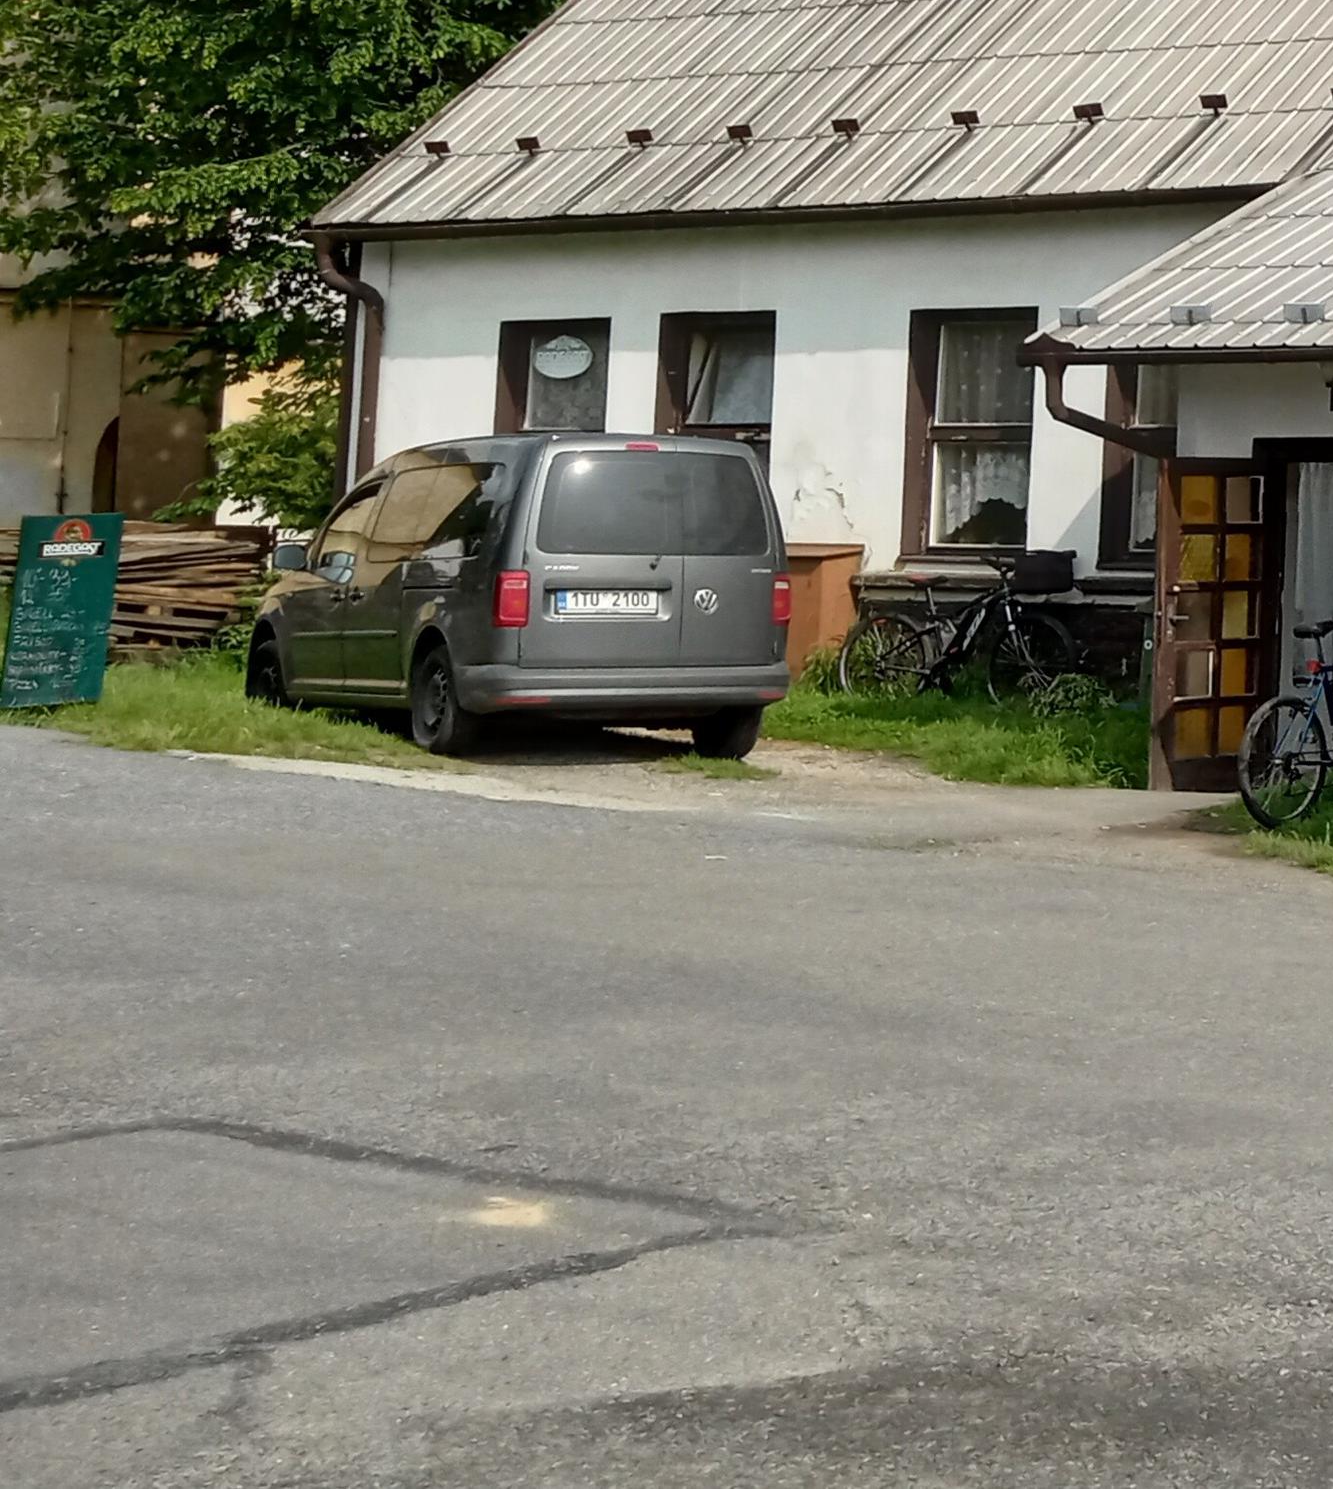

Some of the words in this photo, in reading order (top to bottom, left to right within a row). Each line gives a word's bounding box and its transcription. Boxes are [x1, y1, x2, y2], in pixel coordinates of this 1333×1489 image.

[42, 542, 102, 557] RADEGAST
[571, 591, 600, 608] 1TU
[612, 591, 650, 608] 2100
